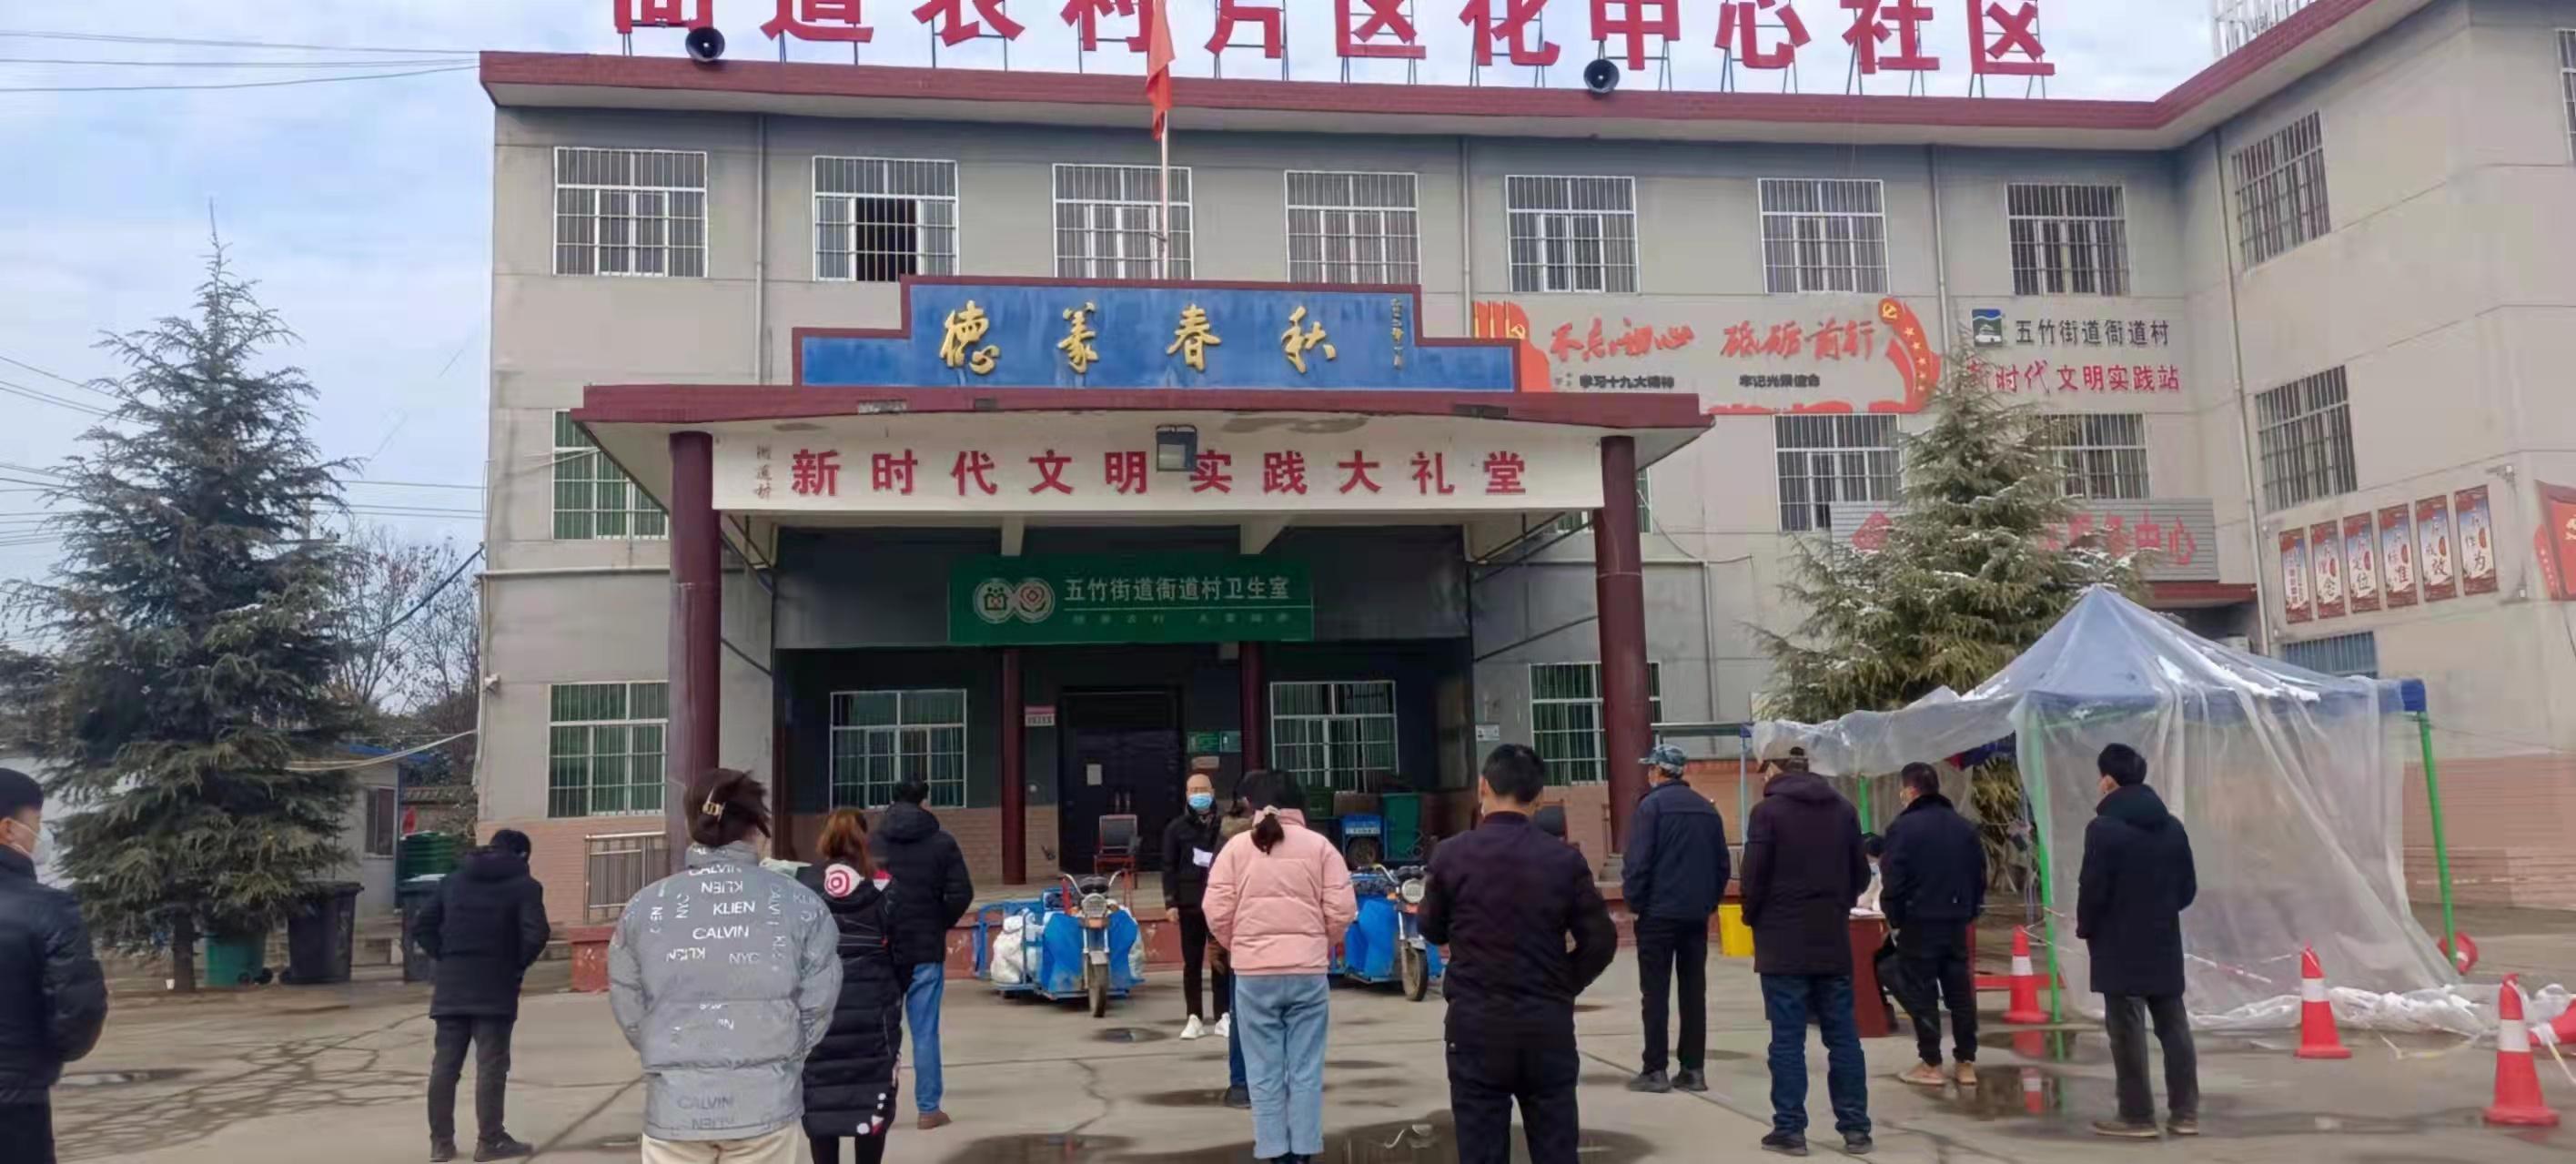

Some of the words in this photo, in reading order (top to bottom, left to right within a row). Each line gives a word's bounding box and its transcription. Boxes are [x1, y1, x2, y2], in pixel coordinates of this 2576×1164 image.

[791, 449, 1527, 497] 新时代文明实践大礼堂
[712, 900, 756, 916] KLIEN
[692, 925, 749, 940] CALVIN
